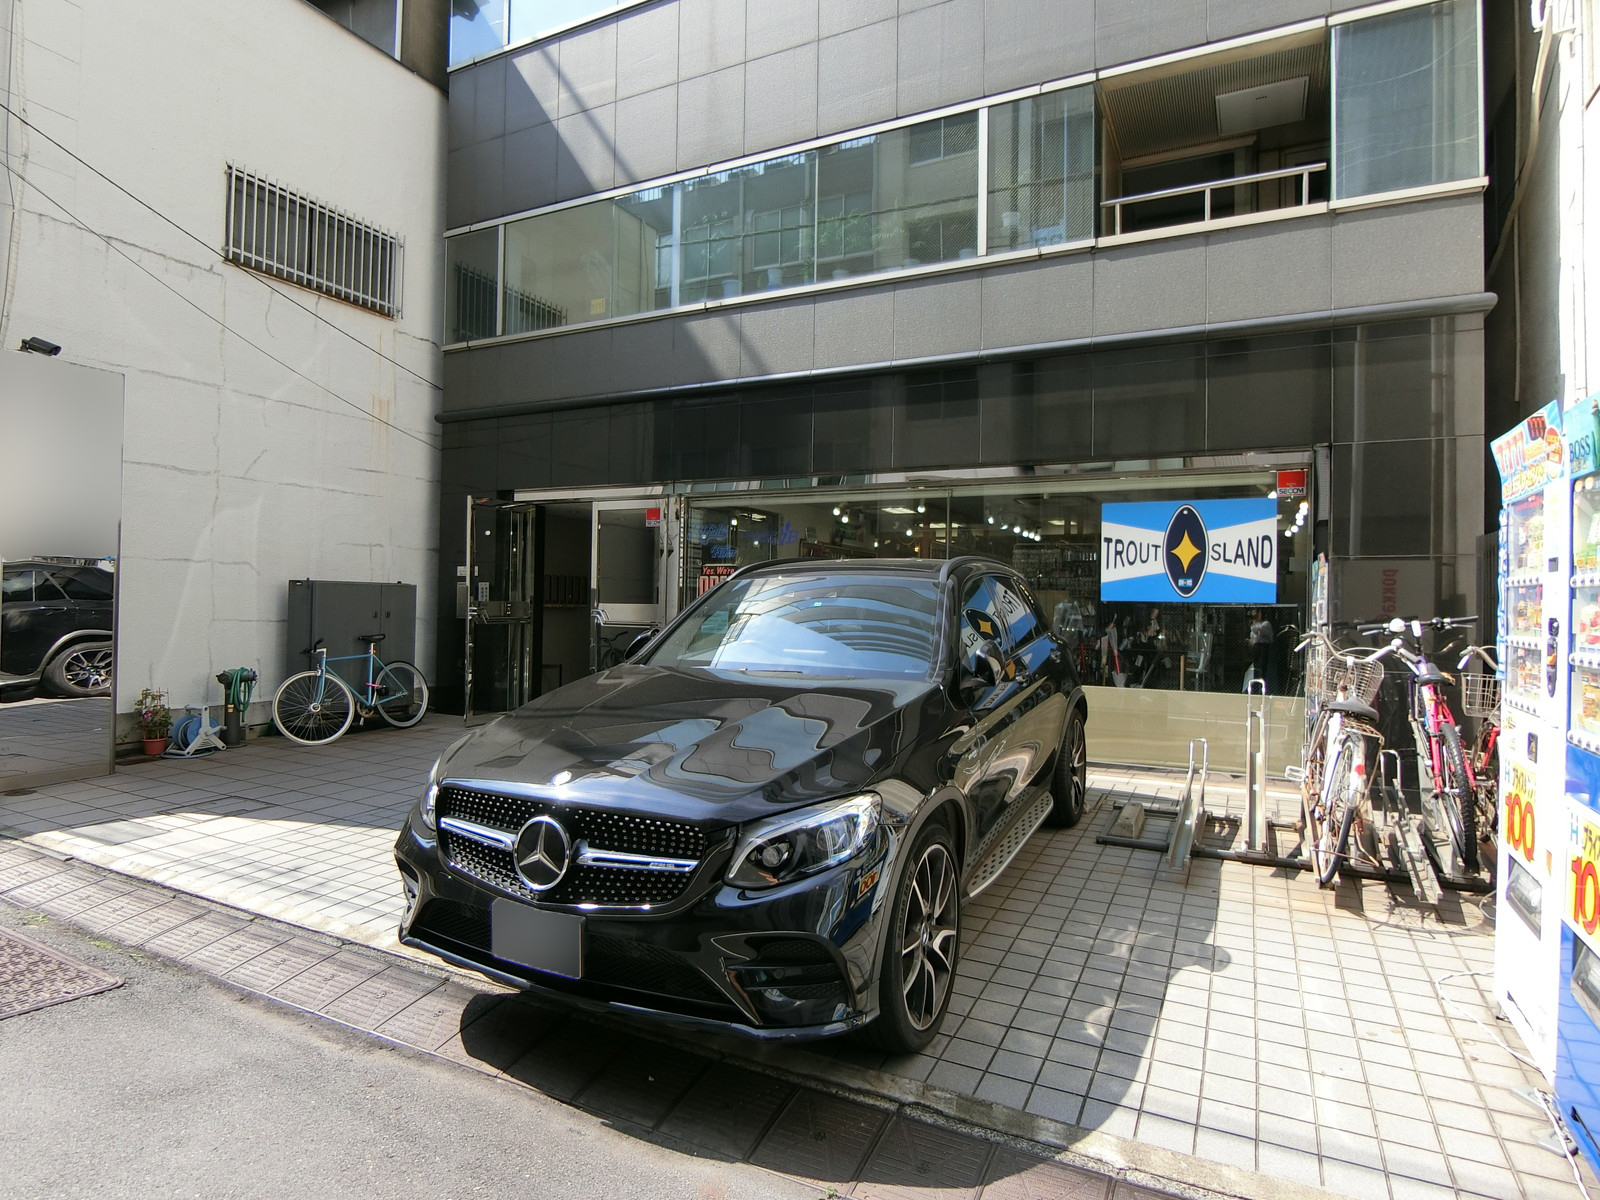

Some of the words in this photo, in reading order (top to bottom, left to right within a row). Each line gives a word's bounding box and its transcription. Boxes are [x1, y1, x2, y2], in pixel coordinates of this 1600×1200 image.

[1569, 434, 1591, 462] BOSS
[1278, 487, 1305, 495] SECOM
[1103, 537, 1161, 570] TROUT
[1505, 792, 1536, 863] 100
[1571, 856, 1600, 936] 10
